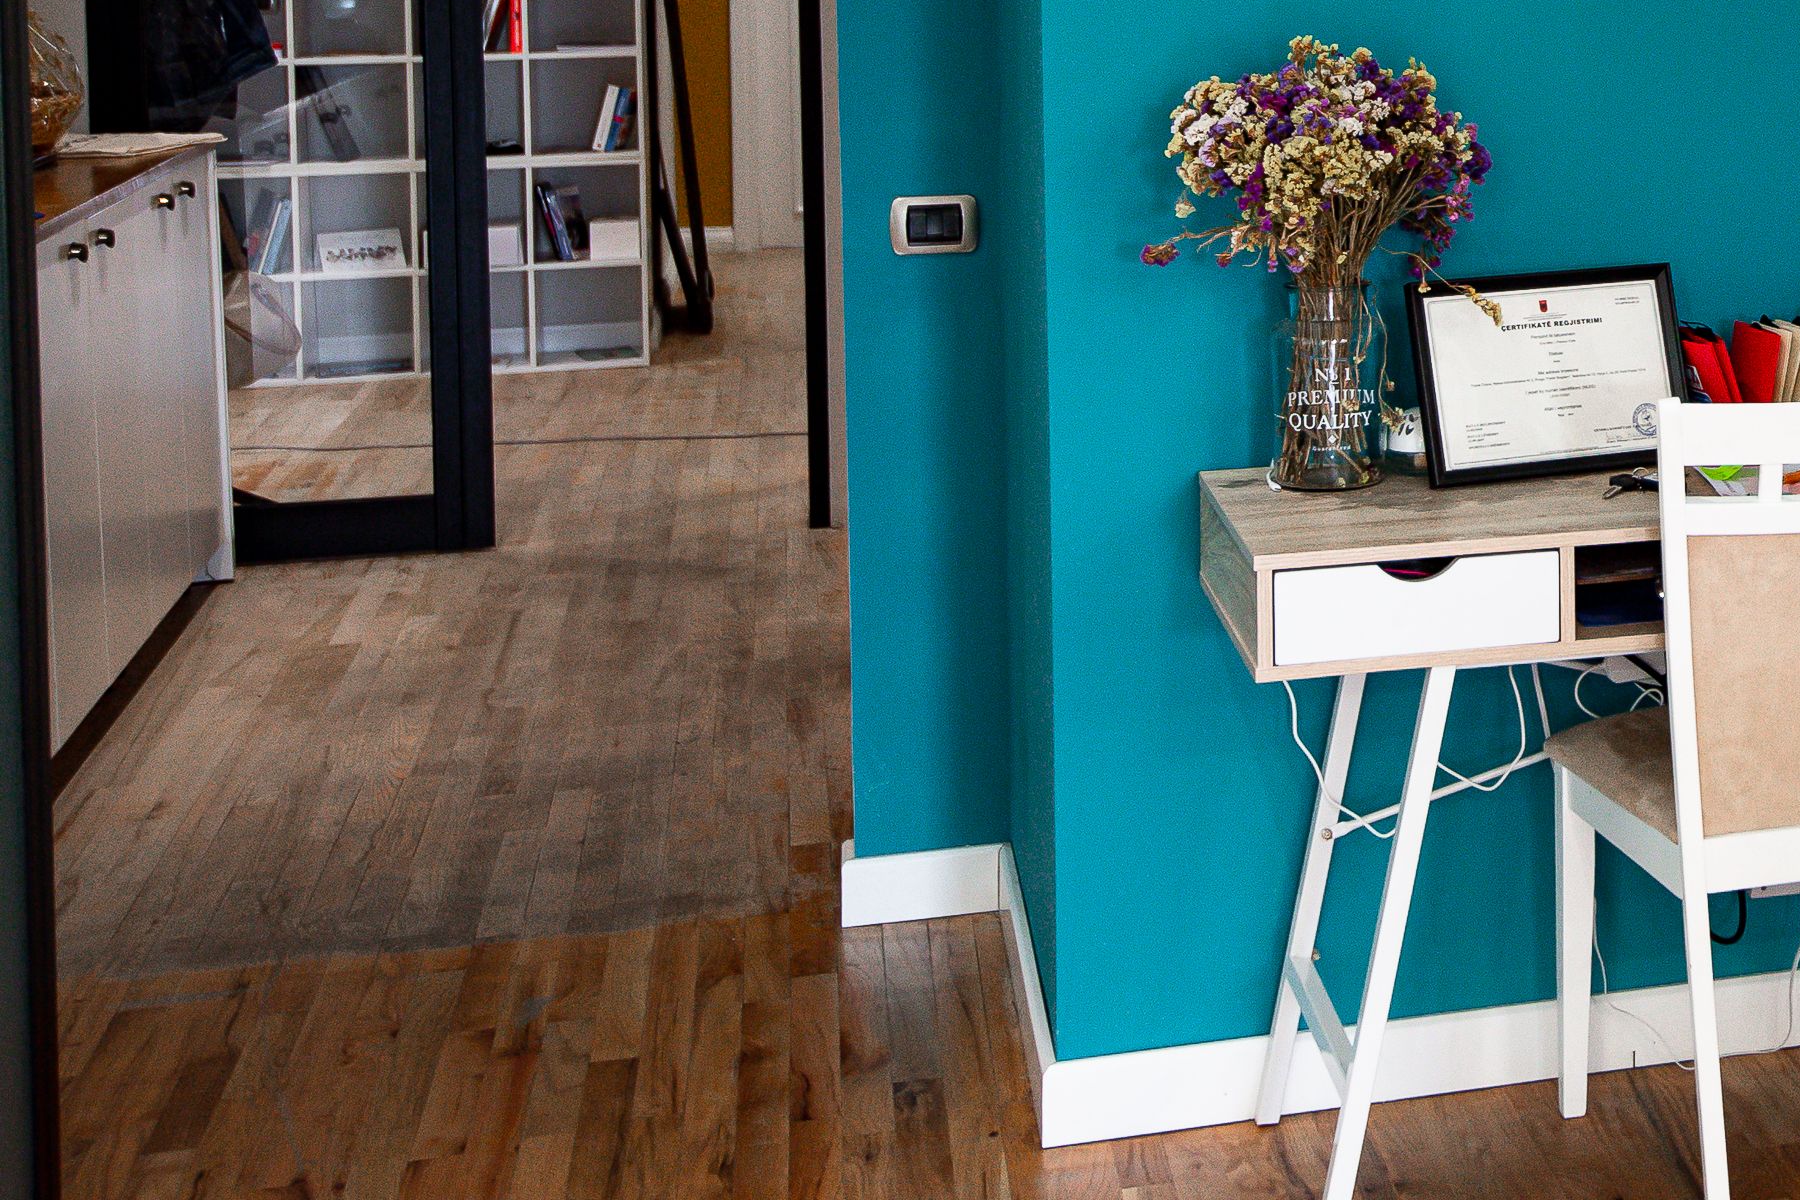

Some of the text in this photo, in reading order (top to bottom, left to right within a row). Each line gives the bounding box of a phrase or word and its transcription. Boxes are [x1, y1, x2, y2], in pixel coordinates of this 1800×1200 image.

[1553, 317, 1603, 327] REGJISTRIMI
[1288, 389, 1375, 406] PREMIUM
[1288, 409, 1373, 432] QUALITY
